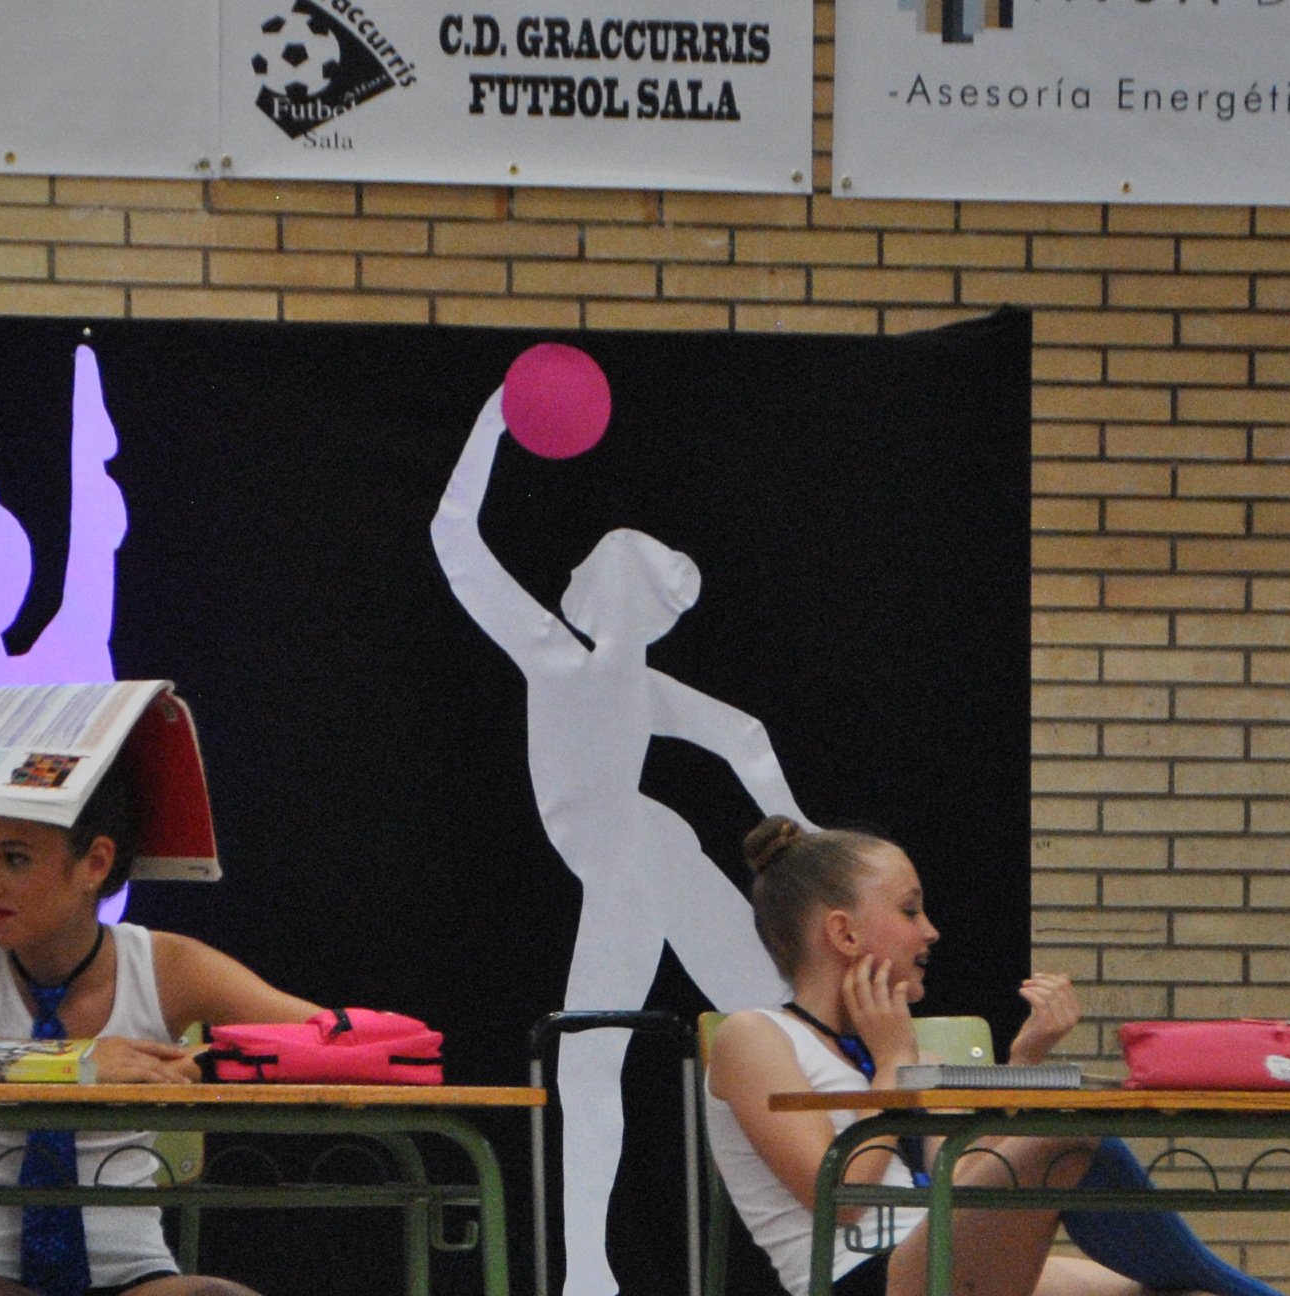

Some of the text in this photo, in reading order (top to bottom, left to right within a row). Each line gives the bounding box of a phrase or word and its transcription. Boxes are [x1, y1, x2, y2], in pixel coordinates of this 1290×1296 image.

[439, 15, 771, 63] C.D. GRACCURRIS
[468, 71, 741, 120] FUTBOL SALA
[303, 131, 354, 149] Sala
